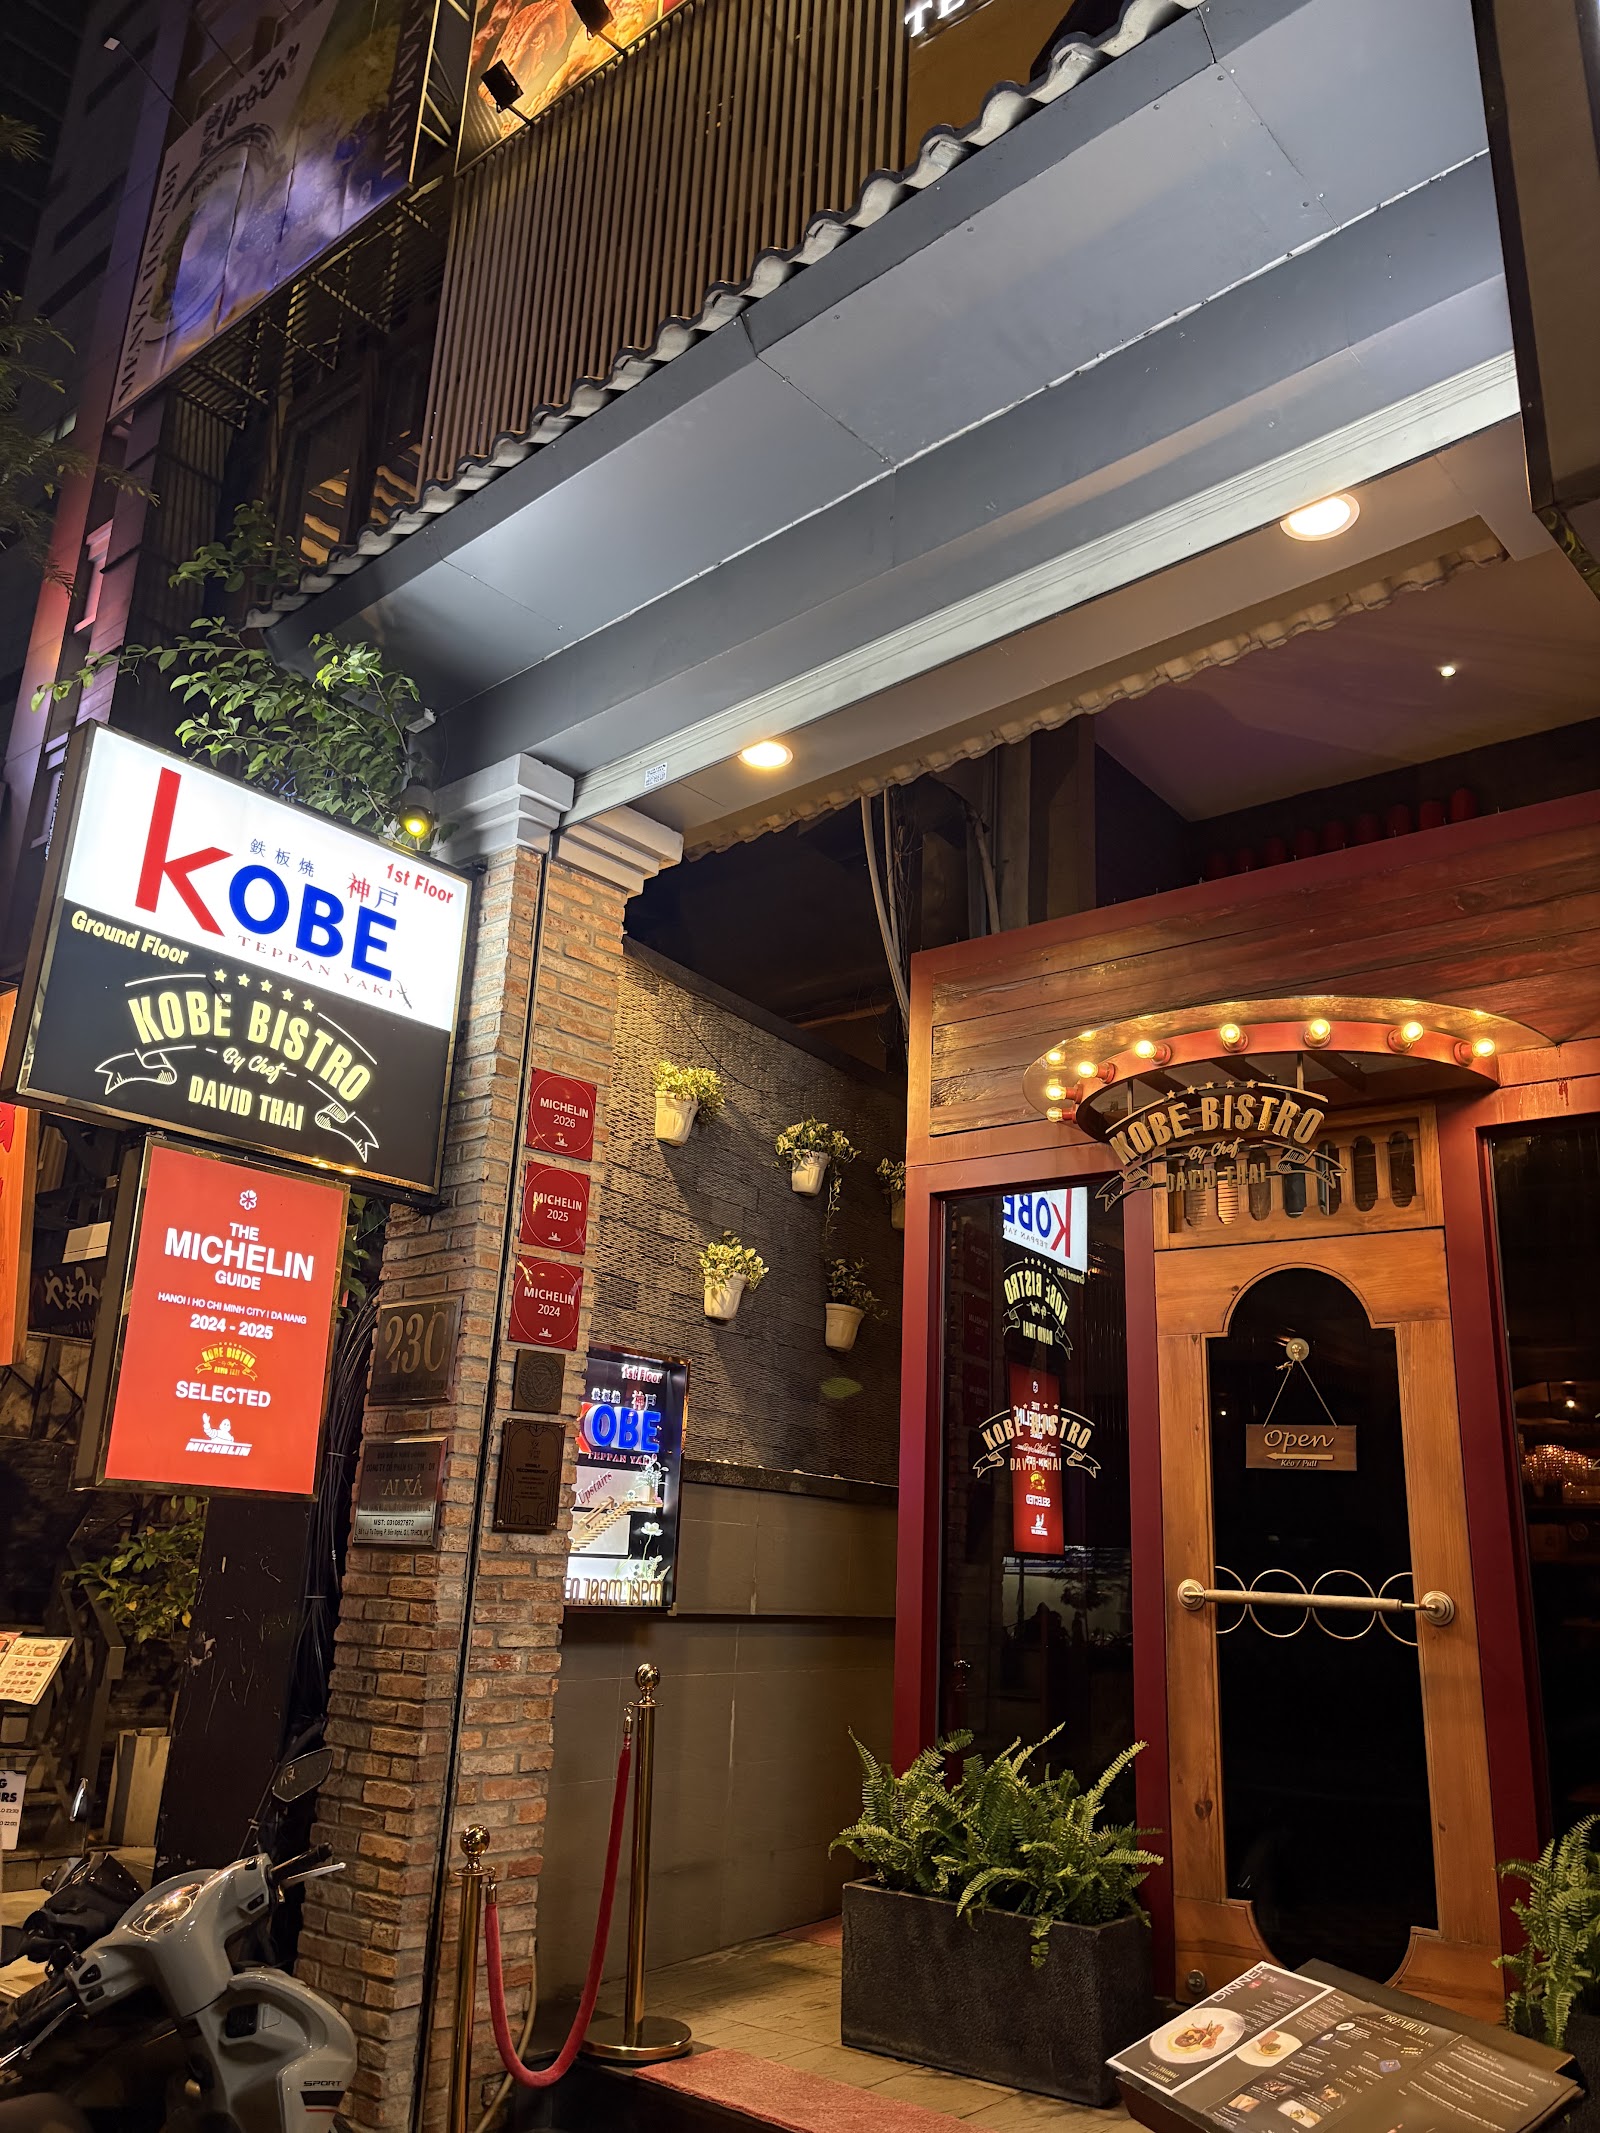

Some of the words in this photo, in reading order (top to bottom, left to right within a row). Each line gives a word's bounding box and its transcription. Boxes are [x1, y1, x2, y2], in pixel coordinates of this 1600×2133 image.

[135, 766, 398, 982] KOBE
[387, 863, 410, 887] 1st
[414, 874, 454, 905] Floor
[346, 872, 400, 909] 神戸
[71, 909, 140, 953] Ground
[141, 933, 190, 966] Floor
[237, 934, 331, 977] TEPPAN
[344, 972, 393, 999] YAKI
[222, 1046, 245, 1074] By
[248, 1054, 283, 1084] Chef
[247, 1000, 372, 1103] BISTRO
[188, 1075, 252, 1117] DAVID
[259, 1094, 305, 1131] THAI
[540, 1097, 589, 1119] MICHELIN
[553, 1114, 577, 1129] 2026
[1109, 1102, 1195, 1167] KOBE
[1201, 1093, 1325, 1145] BISTRO
[1188, 1146, 1205, 1165] By
[1210, 1137, 1246, 1159] Chef
[1166, 1168, 1217, 1193] DAVID
[1224, 1163, 1266, 1187] THAI
[533, 1191, 583, 1212] MICHELIN
[546, 1208, 570, 1223] 2025
[229, 1222, 260, 1242] THE
[164, 1227, 315, 1282] MICHELIN
[215, 1269, 262, 1291] GUIDE
[158, 1291, 186, 1305] HANOI
[192, 1297, 206, 1308] HO
[207, 1300, 222, 1310] CHI
[223, 1303, 245, 1314] MINH
[246, 1306, 266, 1318] CITY
[271, 1312, 283, 1321] DA
[284, 1313, 307, 1325] NANG
[523, 1286, 575, 1306] MICHELIN
[537, 1303, 561, 1318] 2024
[190, 1313, 227, 1332] 2024
[238, 1321, 274, 1340] 2025
[226, 1347, 256, 1368] BISTRO
[622, 1364, 639, 1381] 1st
[639, 1367, 663, 1384] Floor
[176, 1381, 272, 1408] SELECTED
[981, 1417, 1024, 1451] KOBE
[1031, 1414, 1092, 1449] BISTRO
[1264, 1429, 1335, 1453] Open
[185, 1441, 253, 1458] MICHELIN
[588, 1452, 627, 1464] TEPPAN
[577, 1471, 613, 1505] Upstairs
[1209, 1965, 1270, 2003] DINNER
[1379, 2013, 1431, 2038] PREMIUM
[303, 2079, 343, 2088] SPORT
